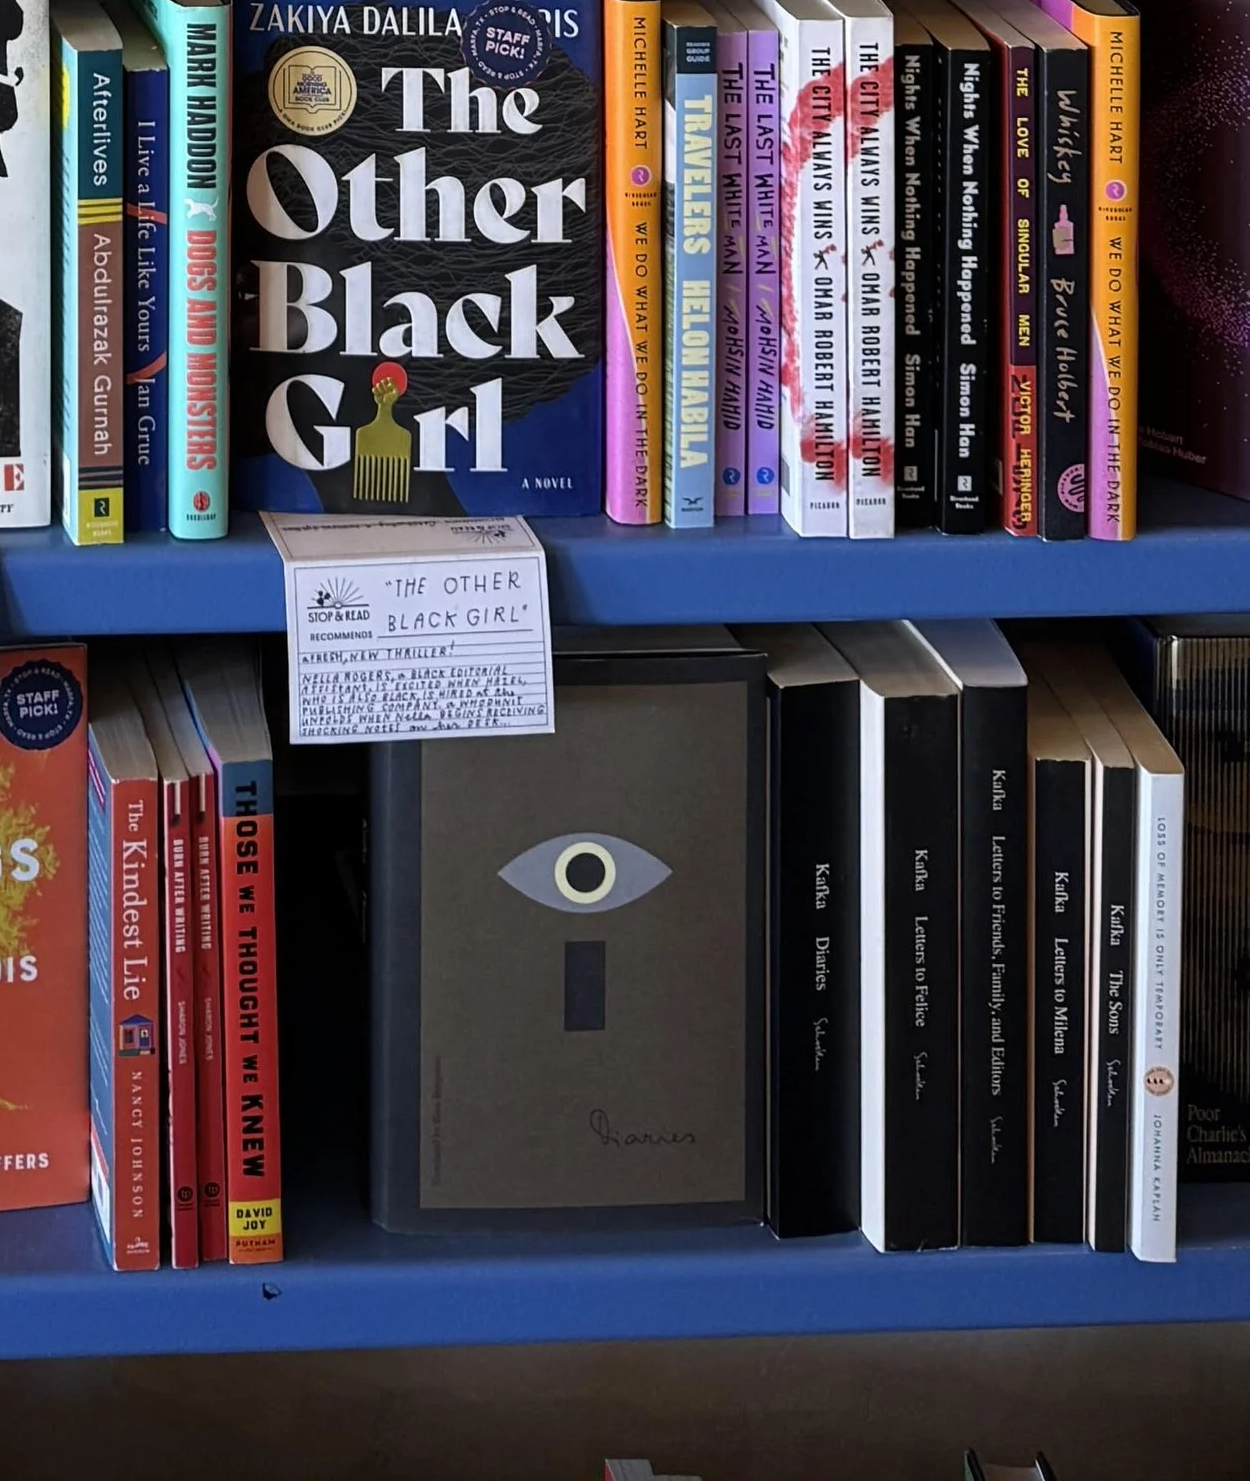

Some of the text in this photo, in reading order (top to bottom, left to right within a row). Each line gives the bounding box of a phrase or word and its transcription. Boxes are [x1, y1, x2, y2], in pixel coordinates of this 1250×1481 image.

[250, 3, 463, 36] ZAKIYA DALILA
[485, 40, 525, 59] PICK!
[486, 26, 530, 44] STAFF
[381, 67, 543, 134] The
[246, 144, 587, 244] Other
[250, 260, 585, 359] Black
[679, 94, 713, 469] TRAVELERS HELON HABILA
[814, 863, 829, 993] Kafka Diaries
[1108, 903, 1125, 1035] Kafka The Sons
